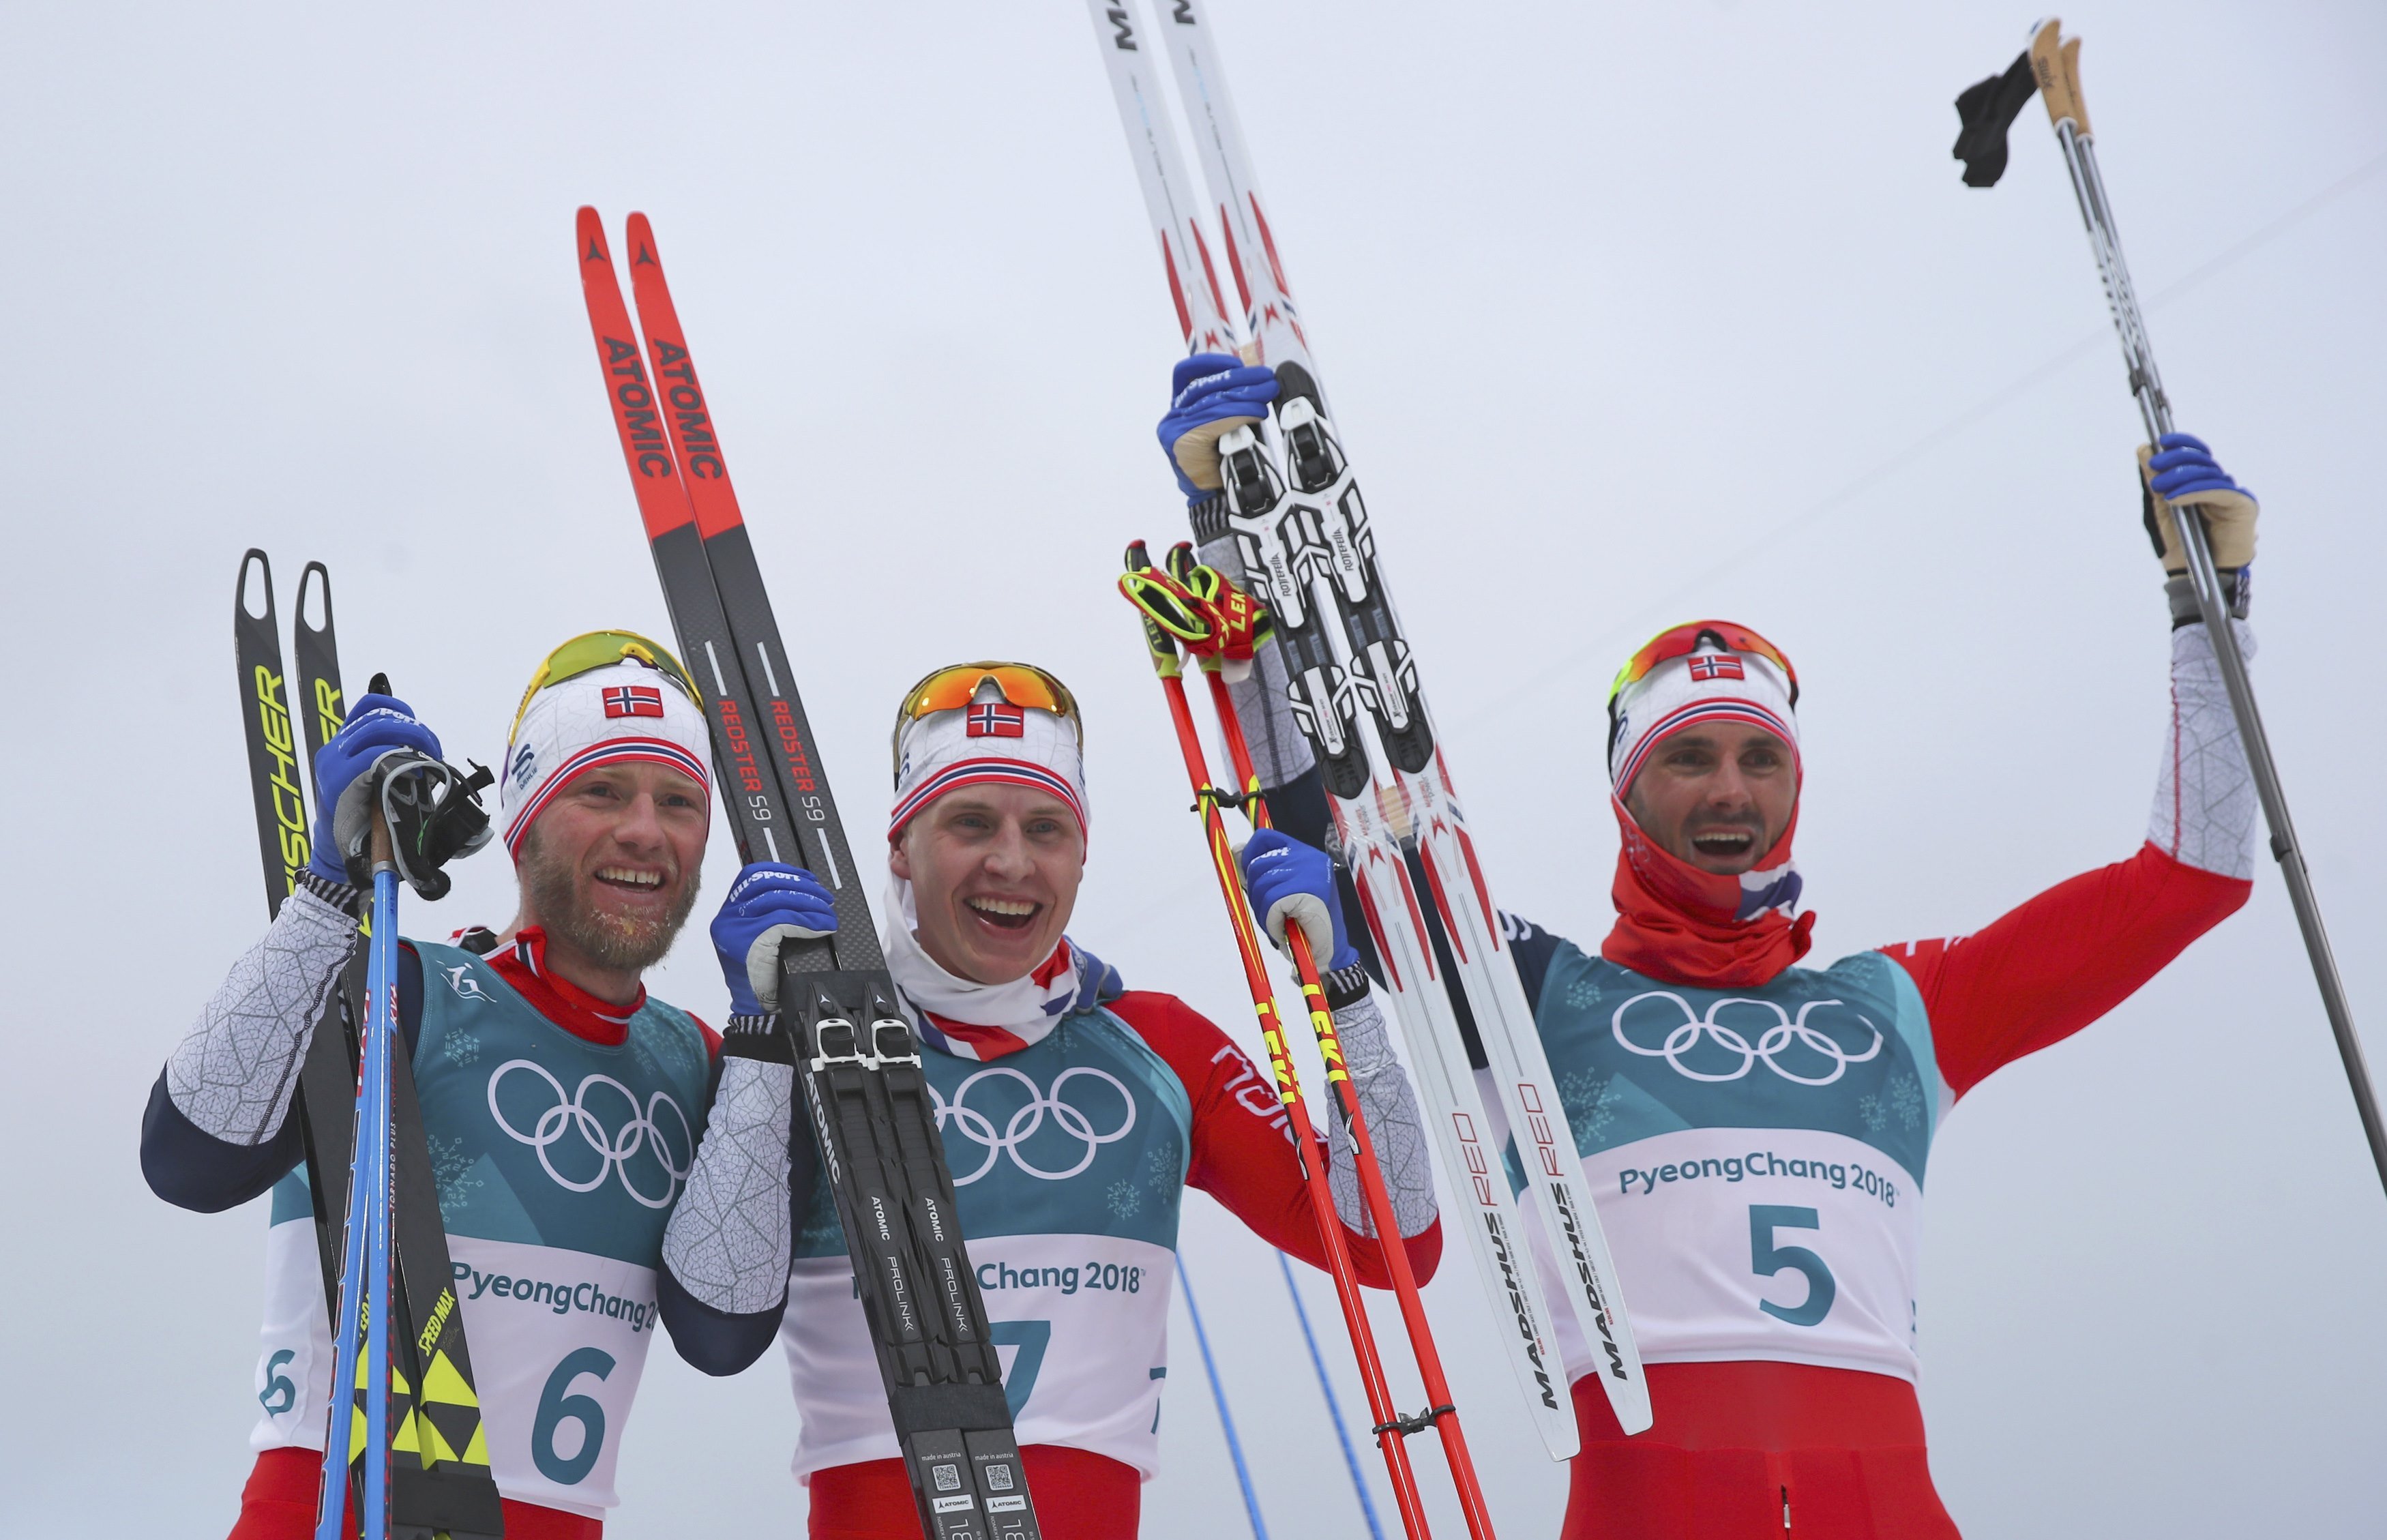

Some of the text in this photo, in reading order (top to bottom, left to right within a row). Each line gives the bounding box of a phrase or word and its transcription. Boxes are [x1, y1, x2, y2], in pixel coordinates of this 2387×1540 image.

[602, 336, 671, 478] ATOMIC
[653, 338, 722, 479] ATOMIC
[1230, 593, 1245, 632] LEK
[717, 700, 771, 820] REDSTER S9
[770, 700, 825, 821] REDSTER S9
[805, 1072, 840, 1184] ATOMIC
[1620, 1152, 1895, 1207] PyeongChang 2018
[871, 1196, 891, 1241] ATOMIC
[925, 1197, 944, 1242] ATOMIC
[1749, 1204, 1835, 1326] 5
[887, 1256, 914, 1331] PROLINK
[941, 1257, 968, 1331] PROLINK
[1085, 1262, 1140, 1293] 2018
[1484, 1211, 1559, 1411] MADSHUS
[1551, 1182, 1628, 1381] MADSHUS
[258, 1349, 296, 1419] 6
[531, 1346, 617, 1485] 6
[989, 1320, 1051, 1427] 7
[921, 1453, 936, 1462] made
[943, 1451, 962, 1460] austria
